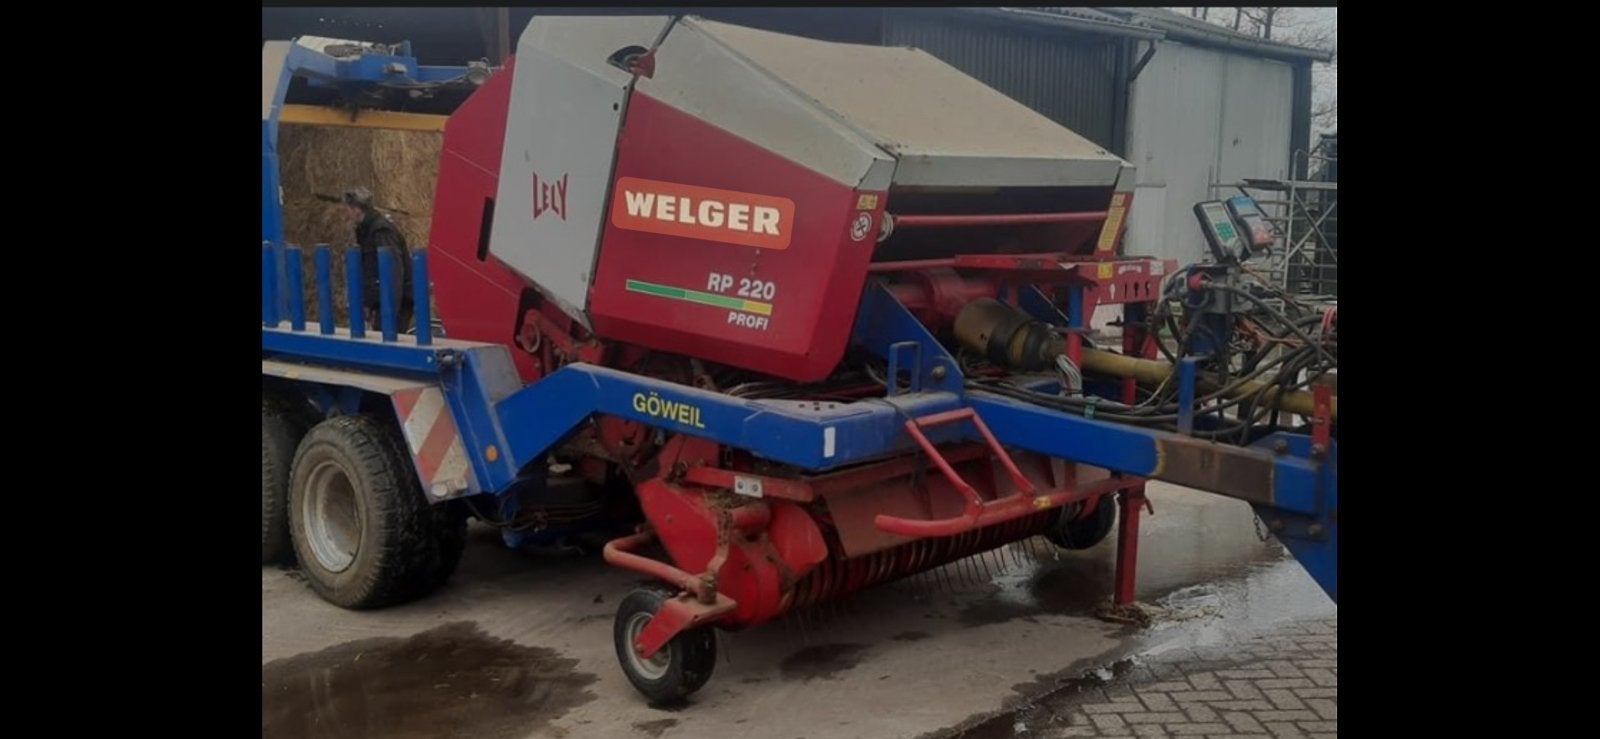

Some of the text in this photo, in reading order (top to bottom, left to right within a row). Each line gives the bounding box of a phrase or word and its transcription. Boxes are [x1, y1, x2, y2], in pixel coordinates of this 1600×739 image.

[532, 172, 569, 221] LELY
[624, 190, 780, 236] WELGER
[707, 272, 776, 301] RP 220
[727, 311, 769, 331] PROFI
[632, 391, 706, 429] GÖWEIL
